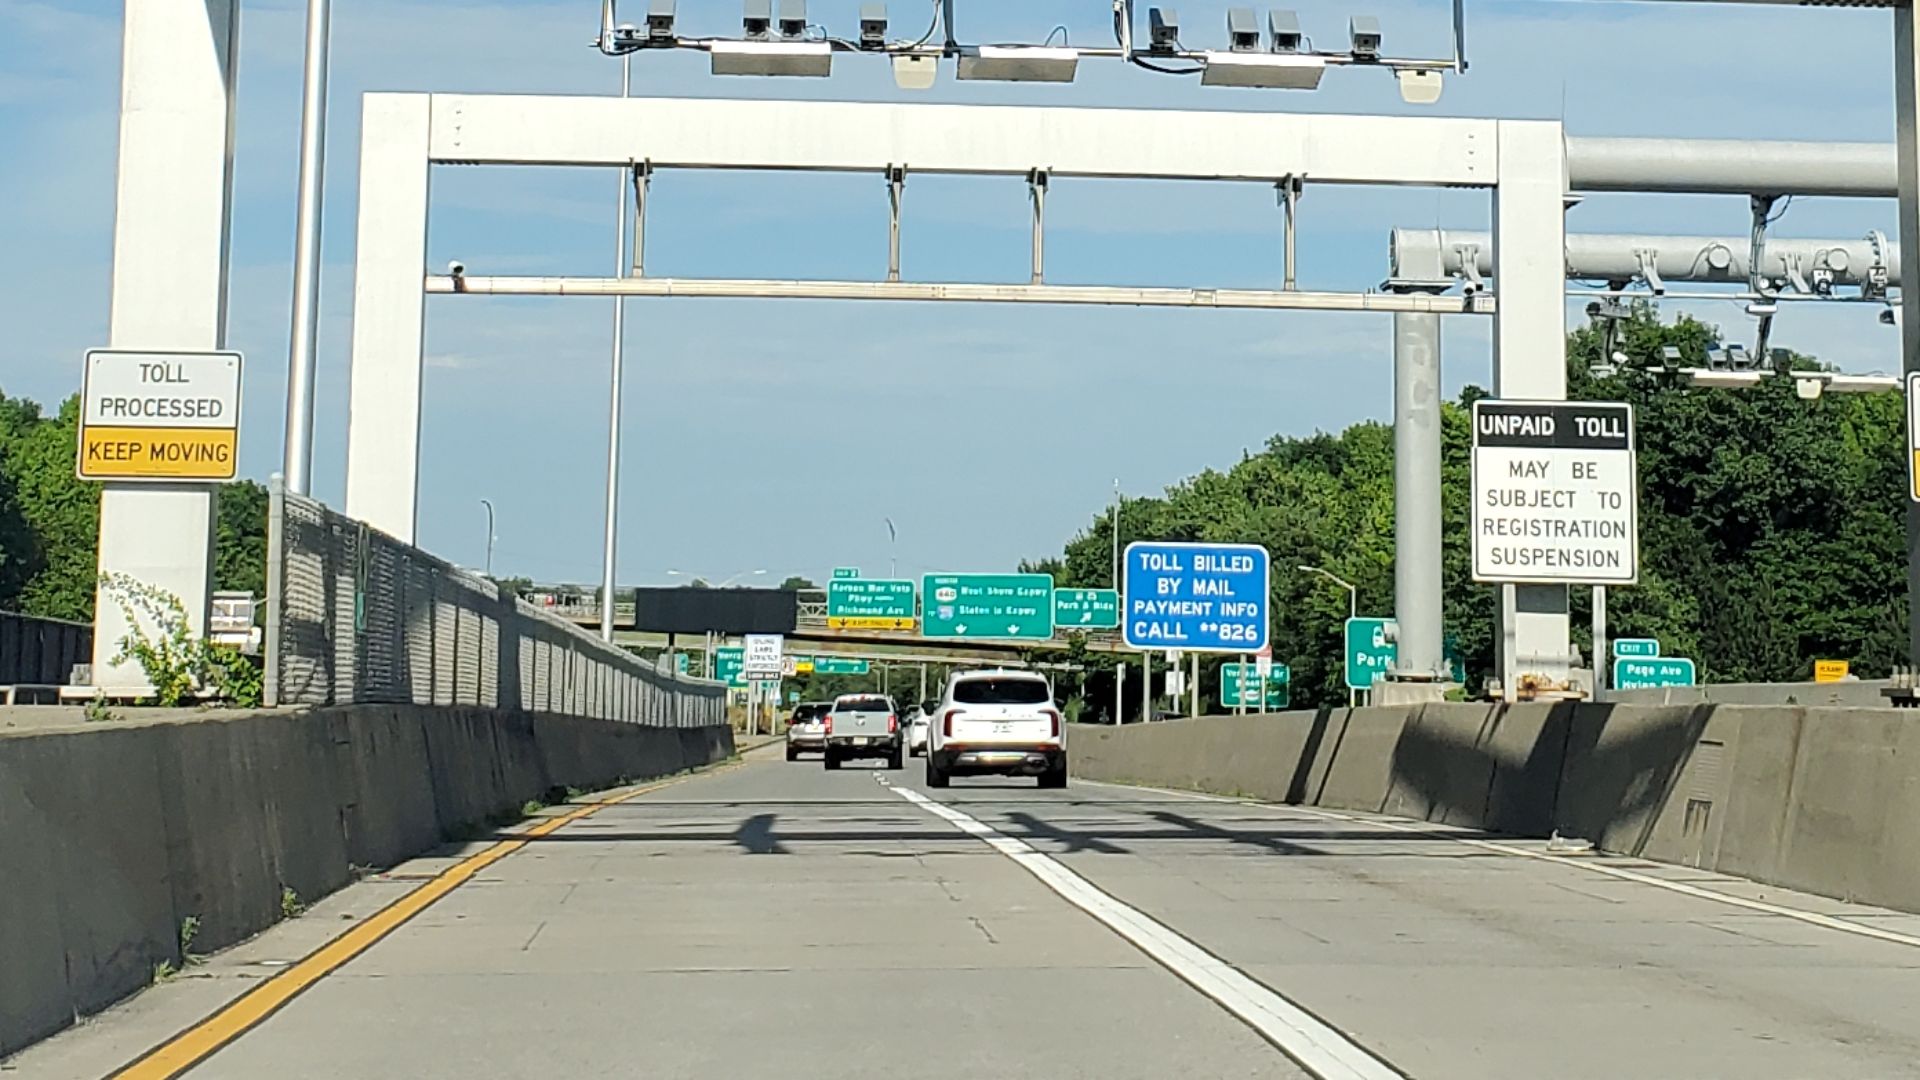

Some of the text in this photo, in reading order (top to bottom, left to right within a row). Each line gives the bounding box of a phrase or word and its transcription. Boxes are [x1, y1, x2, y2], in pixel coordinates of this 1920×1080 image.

[139, 363, 190, 383] TOLL
[100, 397, 223, 418] PROCESSED
[1480, 414, 1626, 438] UNPAID TOLL
[89, 441, 228, 463] KEEP MOVING
[1509, 460, 1598, 480] MAY BE
[1486, 489, 1622, 509] SUBJECT TO
[1483, 518, 1626, 538] REGISTRATION
[1139, 553, 1253, 573] TOLL BILLED
[1491, 547, 1620, 567] SUSPENSION
[1157, 578, 1235, 596] BY MAIL
[1134, 600, 1258, 617] PAYMENT INFO
[1134, 621, 1188, 640] CALL
[1620, 643, 1641, 653] EXIT
[1356, 652, 1393, 667] Park
[1626, 664, 1682, 678] Page Ave
